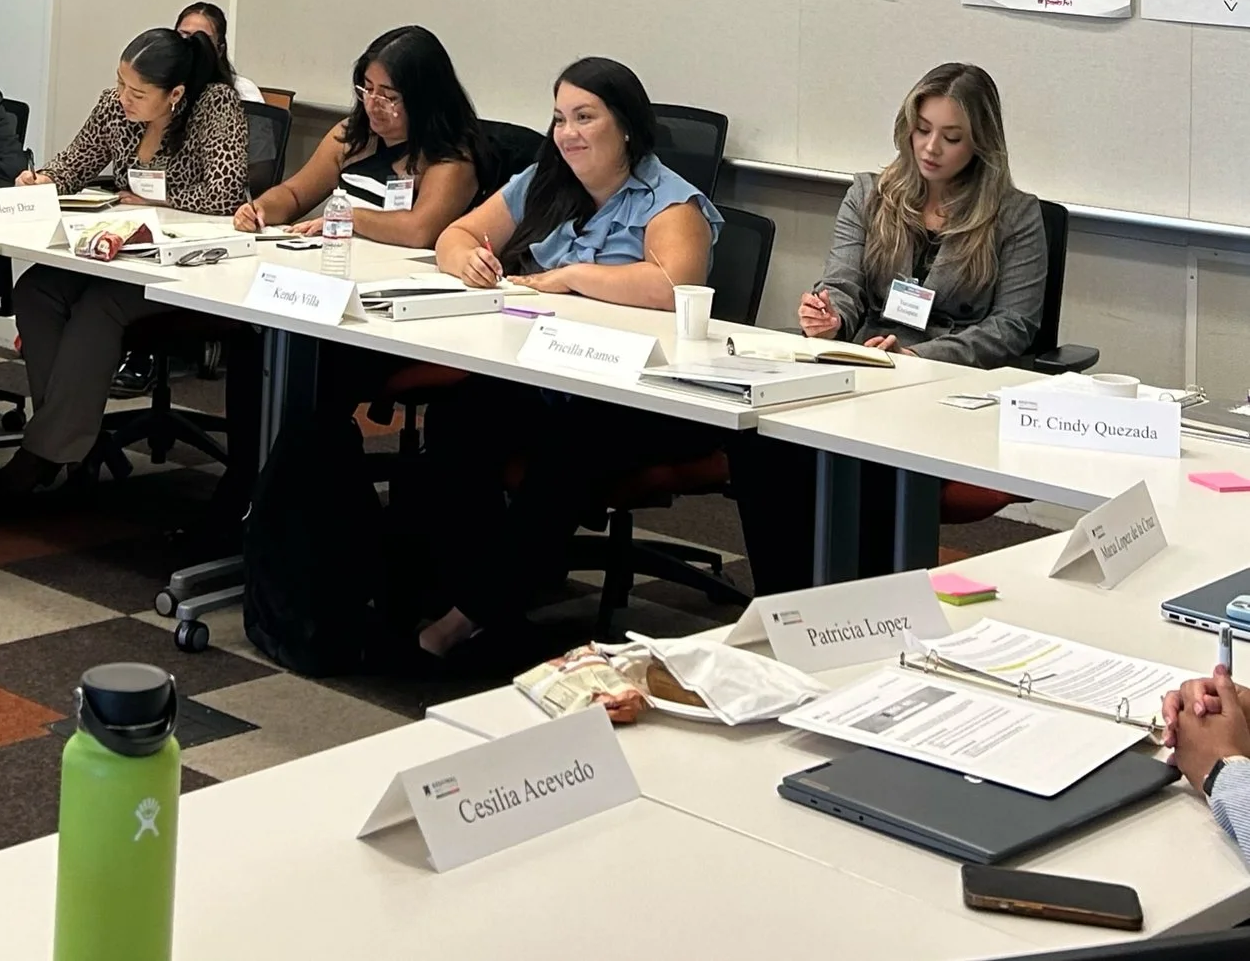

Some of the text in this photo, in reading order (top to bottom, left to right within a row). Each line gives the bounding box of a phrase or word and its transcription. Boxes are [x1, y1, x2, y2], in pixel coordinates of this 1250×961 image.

[273, 287, 320, 308] Kendy Villa
[585, 347, 620, 364] Ramos
[1019, 413, 1158, 440] Dr. Cindy Quezada
[1114, 532, 1133, 551] Lopez
[807, 615, 912, 646] Patricia Lopez
[458, 759, 595, 824] Cesilia Acevedo
